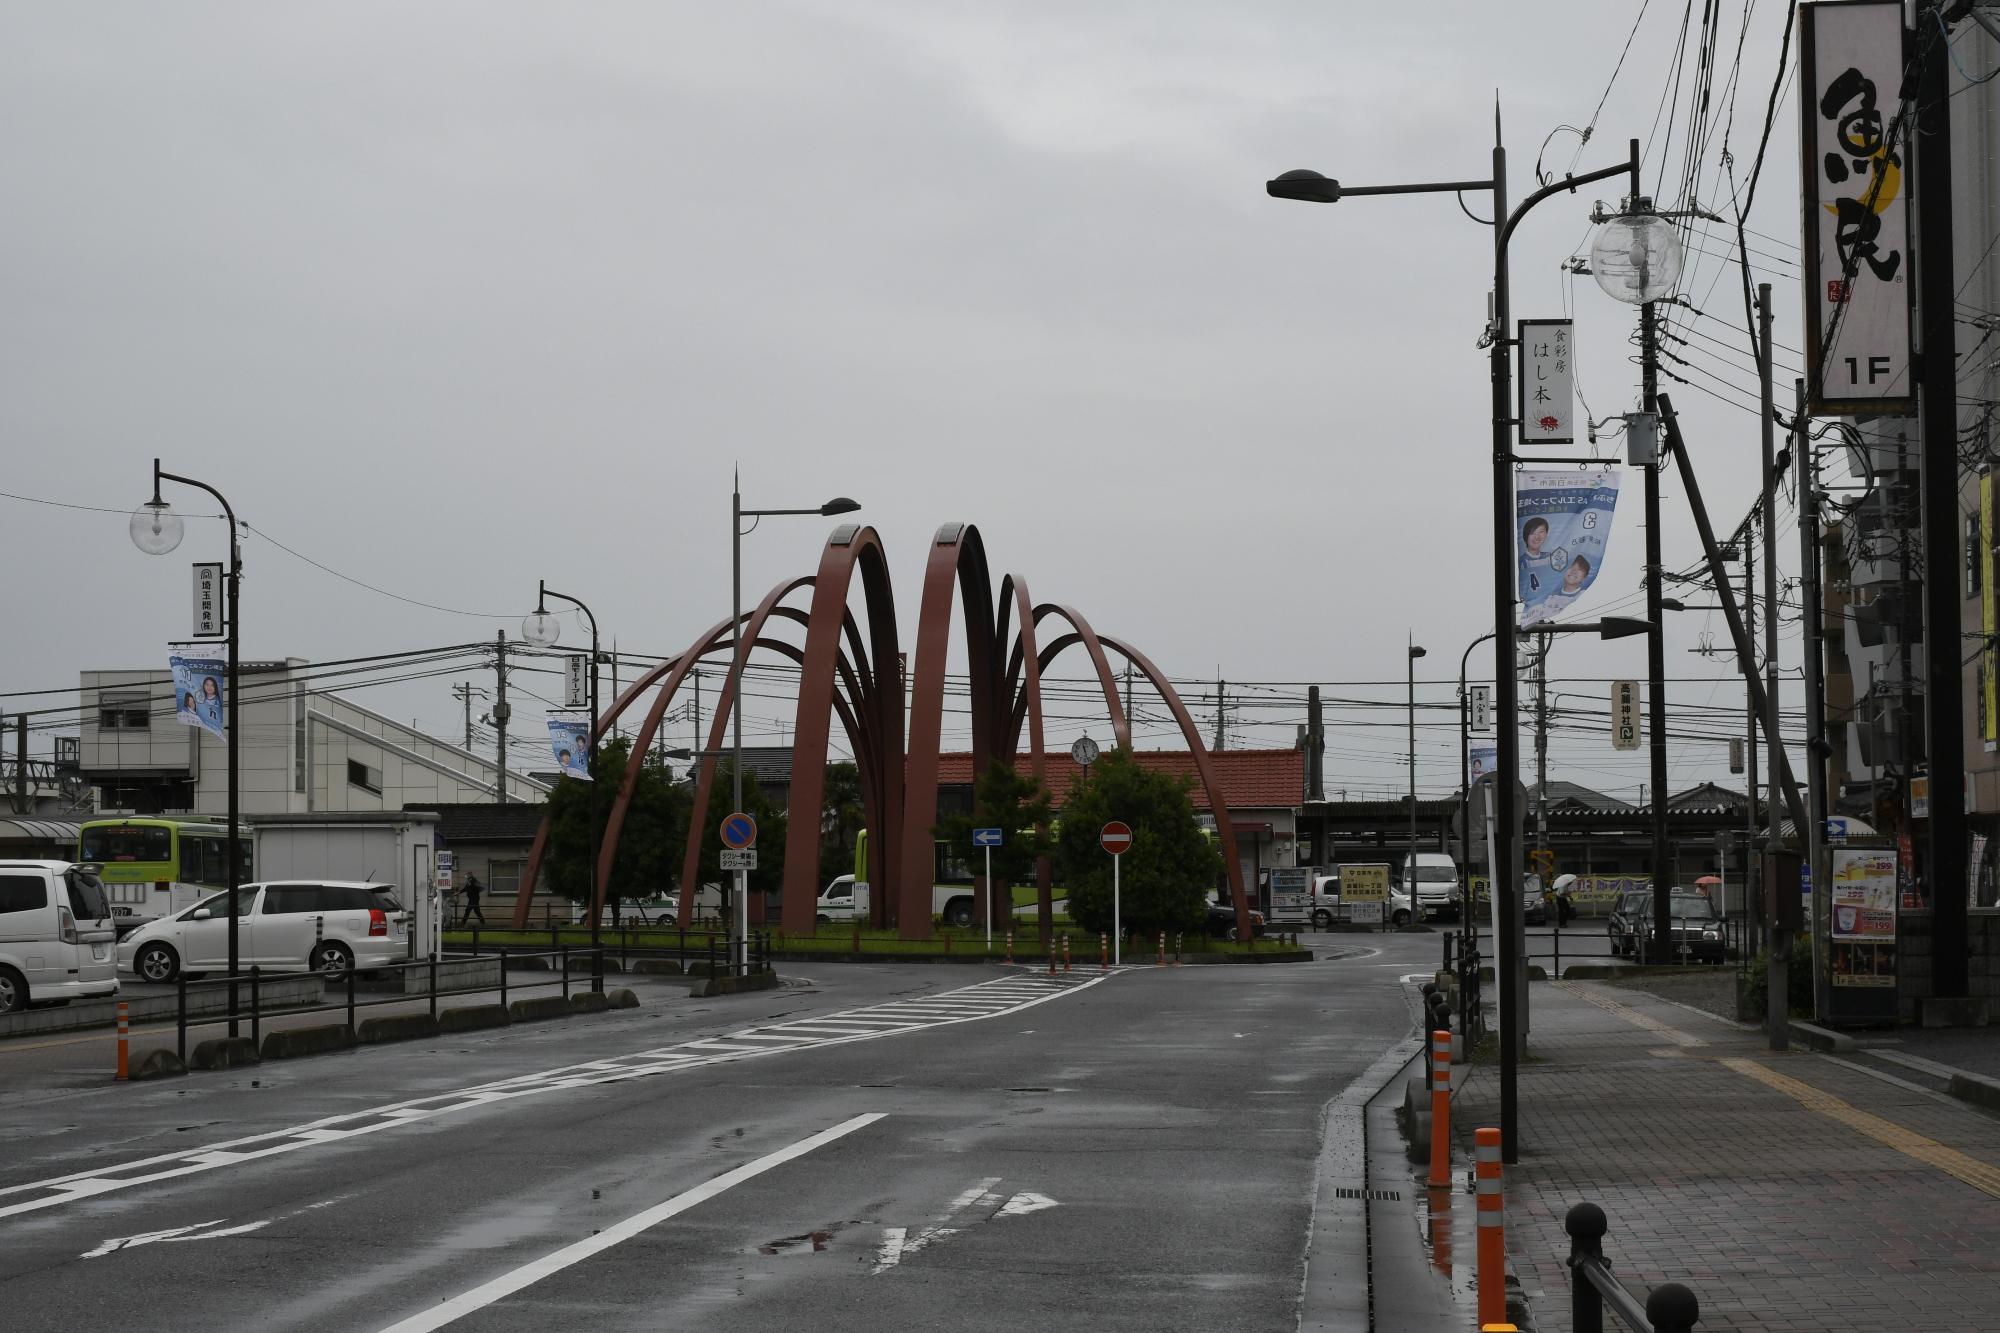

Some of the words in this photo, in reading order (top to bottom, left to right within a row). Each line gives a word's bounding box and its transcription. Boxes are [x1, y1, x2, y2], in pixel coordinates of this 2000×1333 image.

[1532, 343, 1551, 405] はし本
[1554, 329, 1567, 374] 食彩房
[1845, 356, 1890, 385] 1F
[201, 581, 213, 631] 埼玉開発(株)
[571, 657, 581, 703] 日高モータープール
